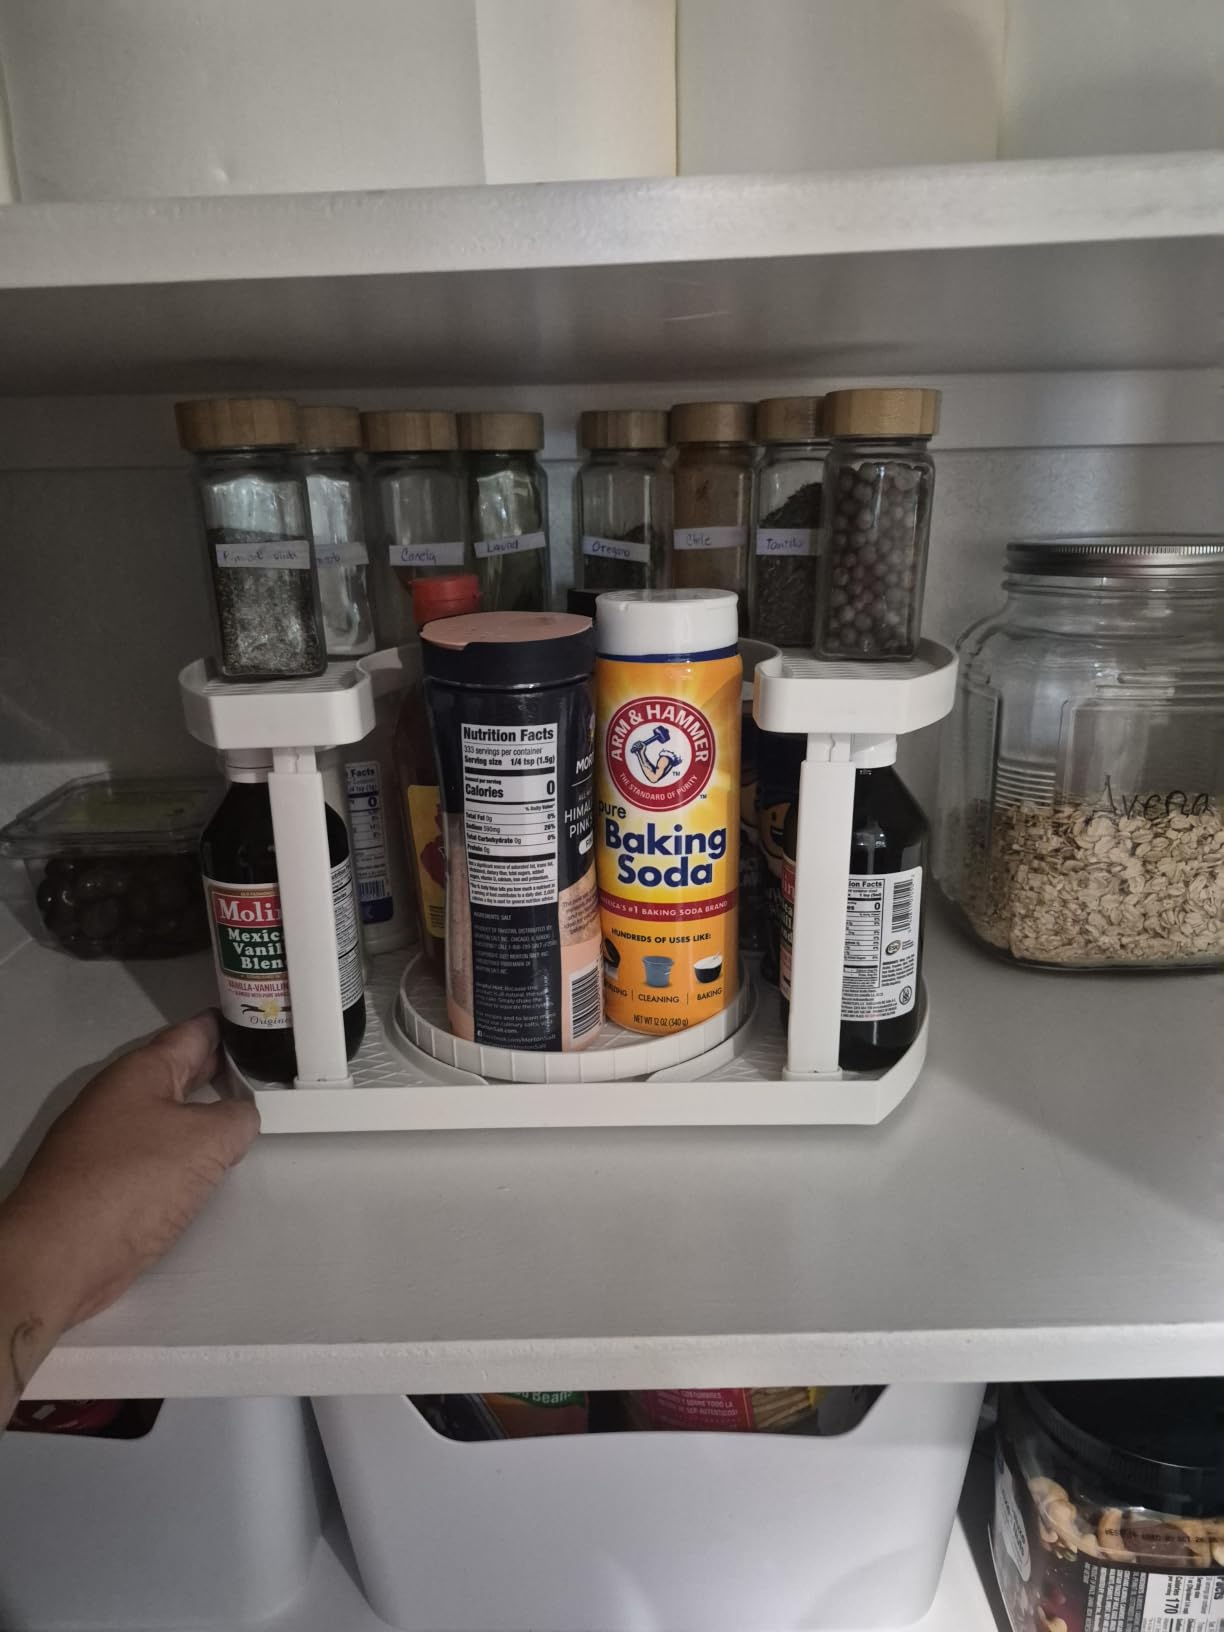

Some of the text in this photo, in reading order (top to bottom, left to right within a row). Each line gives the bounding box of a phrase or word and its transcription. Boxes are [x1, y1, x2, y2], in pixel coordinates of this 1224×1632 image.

[463, 726, 554, 742] Nutrition Facts
[611, 704, 709, 763] ARM & HAMMER
[464, 745, 542, 757] 333 servings per container
[464, 755, 555, 766] Serving size 1/4 tsp (1.5g)
[351, 767, 375, 777] Facts
[465, 780, 555, 798] Calories 0
[620, 772, 698, 801] THE STANDARD OF PURITY
[368, 797, 377, 807] 0
[466, 812, 476, 820] Total
[486, 815, 493, 823] 0g
[466, 822, 483, 831] Sodium
[477, 835, 513, 844] Carbohydrate
[606, 818, 727, 860] Baking
[617, 854, 713, 888] Soda
[628, 905, 638, 914] #1
[642, 908, 676, 916] BAKING
[680, 907, 702, 915] SODA
[705, 900, 728, 913] BRAND
[874, 902, 880, 910] 0
[611, 928, 711, 944] HUNDREDS OF USES LIKE:
[638, 994, 680, 1004] CLEANING
[697, 987, 722, 1001] BAKING
[633, 1013, 644, 1024] NET
[644, 1016, 653, 1024] WT
[654, 1017, 660, 1026] 12
[660, 1018, 668, 1026] OZ
[1164, 1576, 1183, 1614] Calories 170
